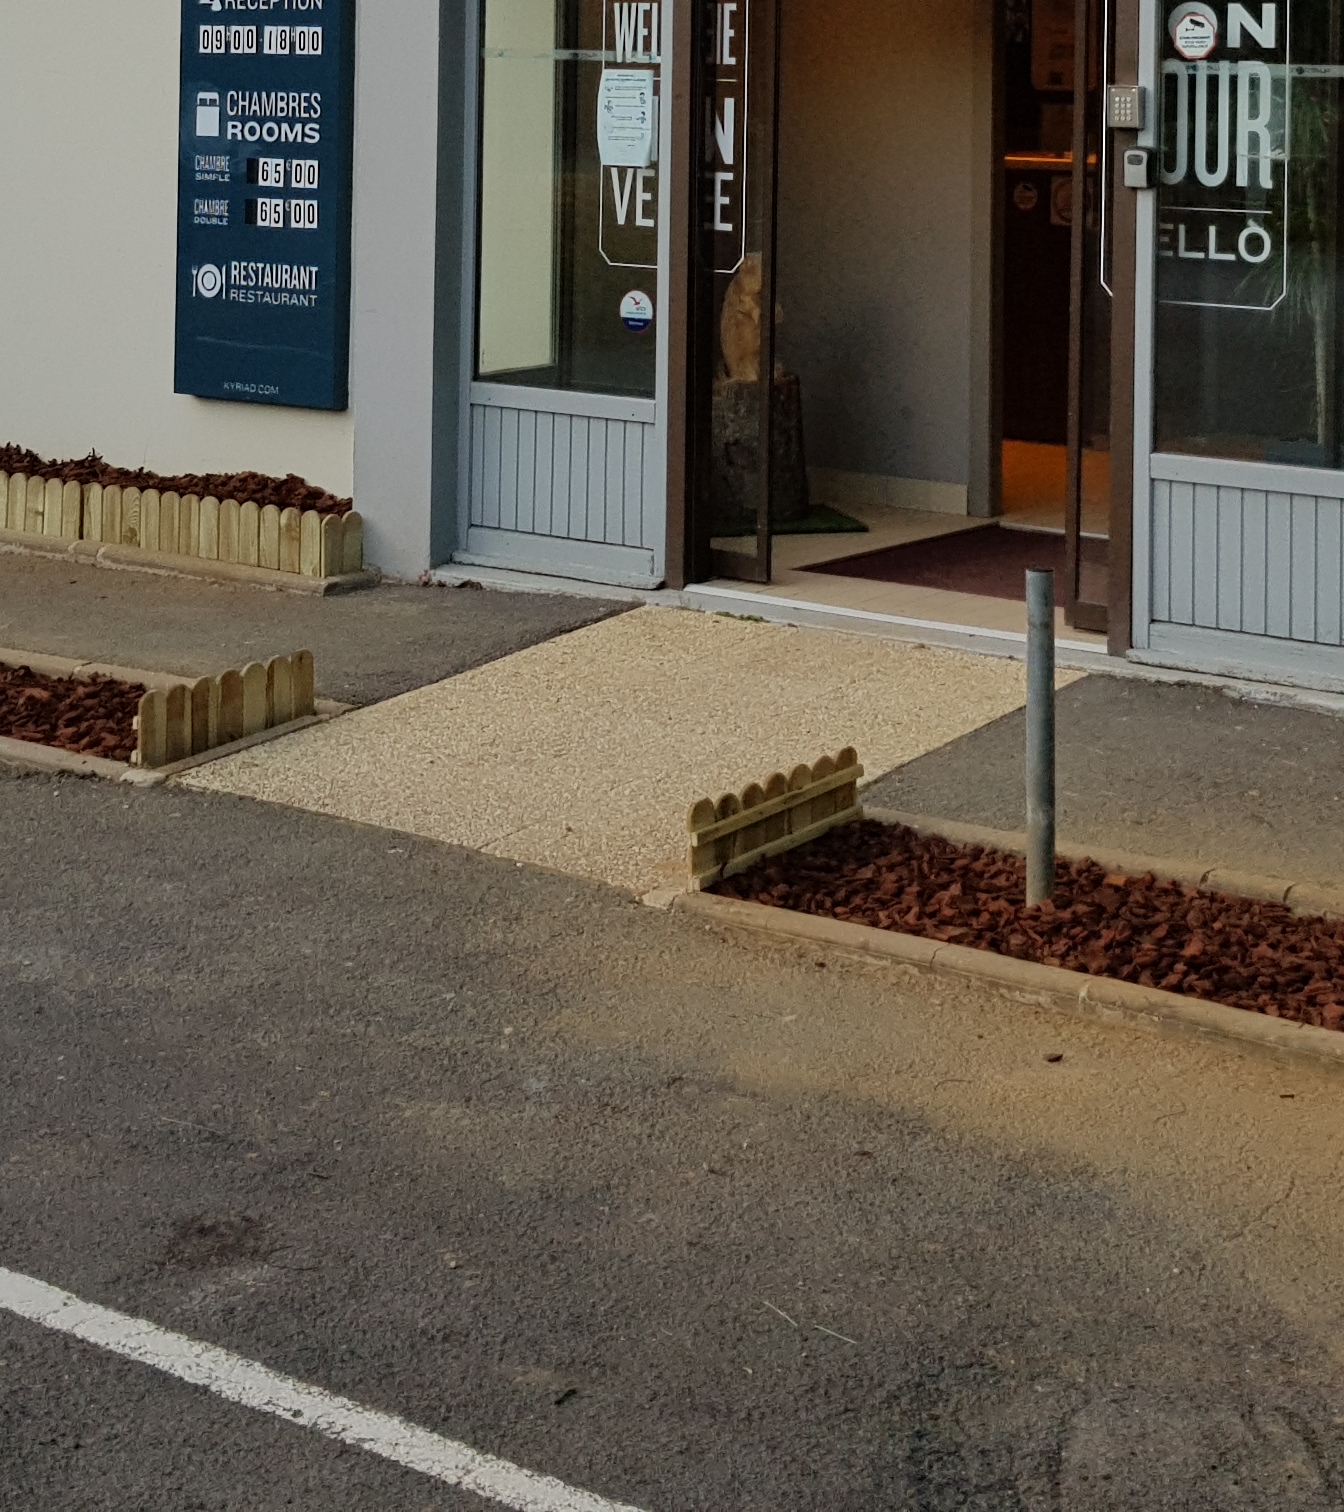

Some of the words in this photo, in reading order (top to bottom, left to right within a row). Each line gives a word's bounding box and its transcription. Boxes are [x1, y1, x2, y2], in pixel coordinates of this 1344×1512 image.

[226, 90, 322, 119] CHAMBRES
[226, 121, 321, 144] ROOMS
[194, 154, 231, 172] CHAMBRE
[195, 172, 231, 182] SIMPLE
[194, 198, 229, 217] CHAMBRE
[194, 216, 229, 226] DOUBLE
[230, 261, 319, 291] RESTAURANT
[229, 290, 318, 307] RESTAURANT
